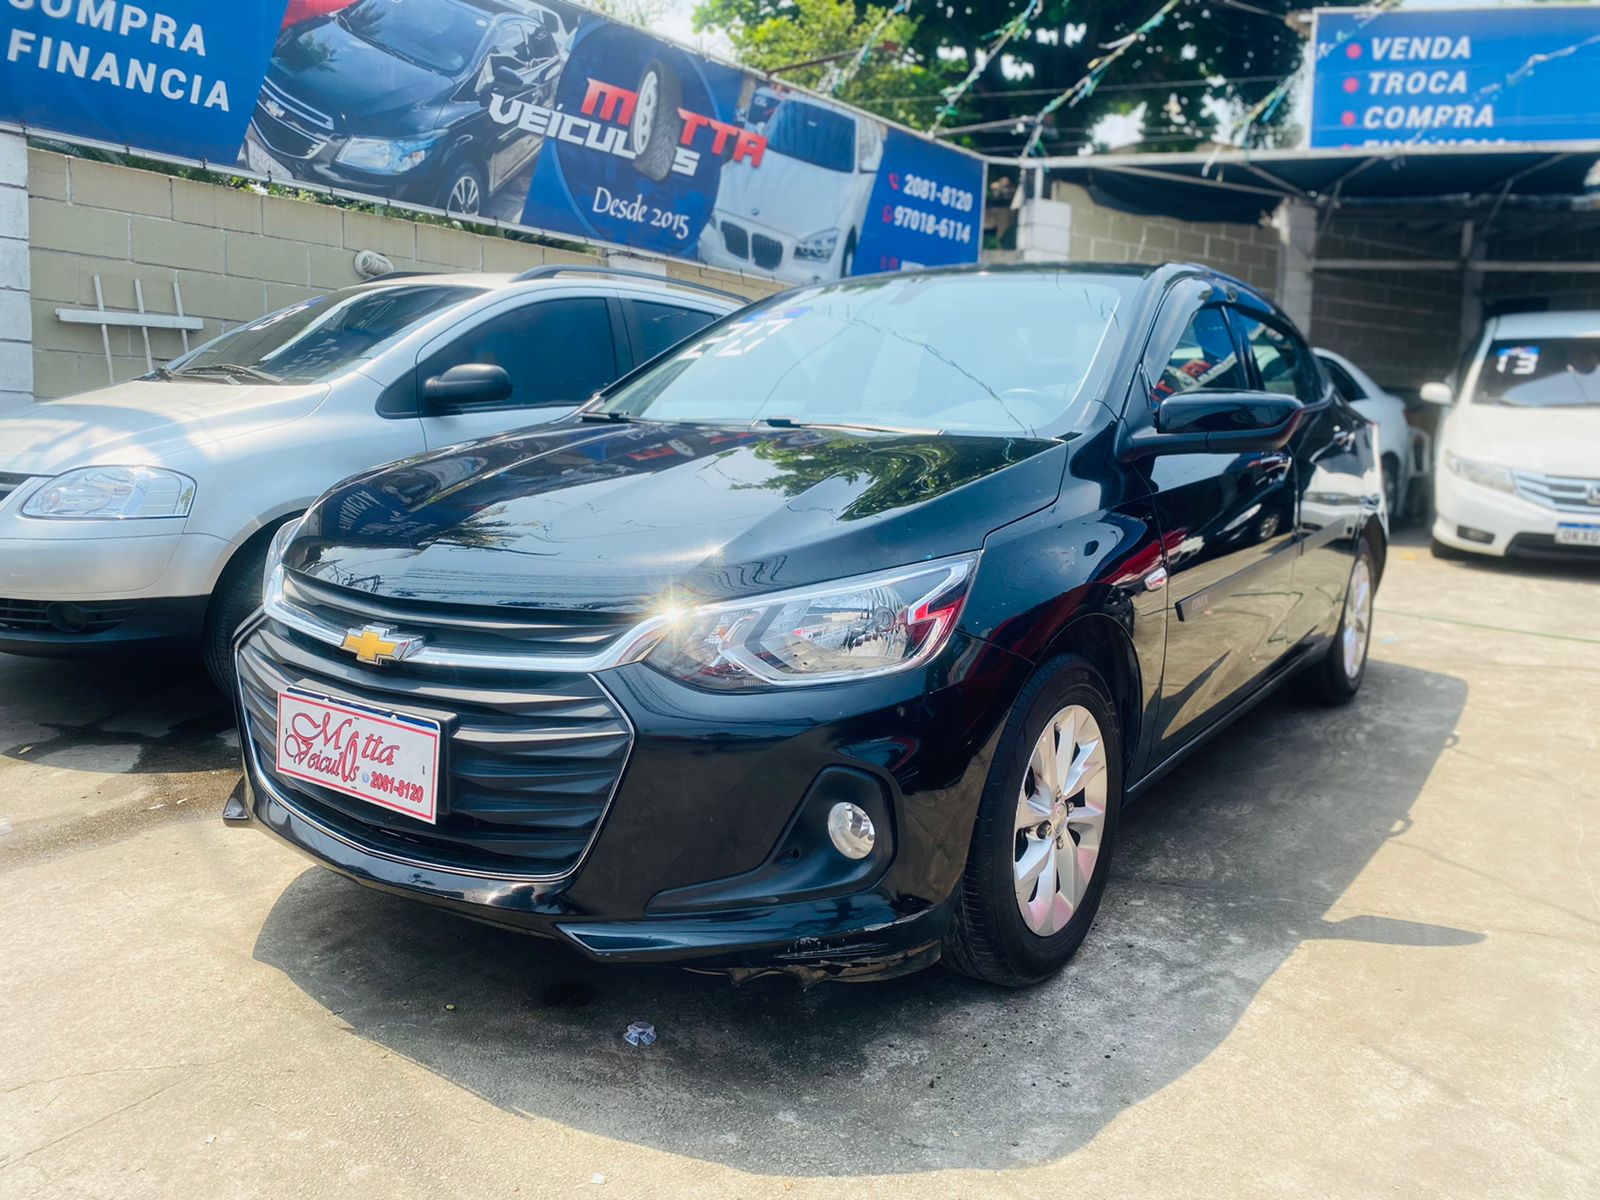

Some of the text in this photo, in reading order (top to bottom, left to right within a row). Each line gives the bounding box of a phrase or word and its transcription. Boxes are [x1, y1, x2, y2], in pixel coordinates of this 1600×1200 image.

[1371, 35, 1472, 60] VENDA
[6, 28, 230, 112] FINANCIA
[1368, 70, 1468, 95] TROCA
[1363, 104, 1494, 129] COMPRA
[903, 173, 974, 212] 2081-8120
[592, 187, 691, 240] Desde 2015
[893, 205, 971, 244] 97018-6114
[1496, 351, 1539, 375] 13
[370, 770, 424, 803] 2081-8120
